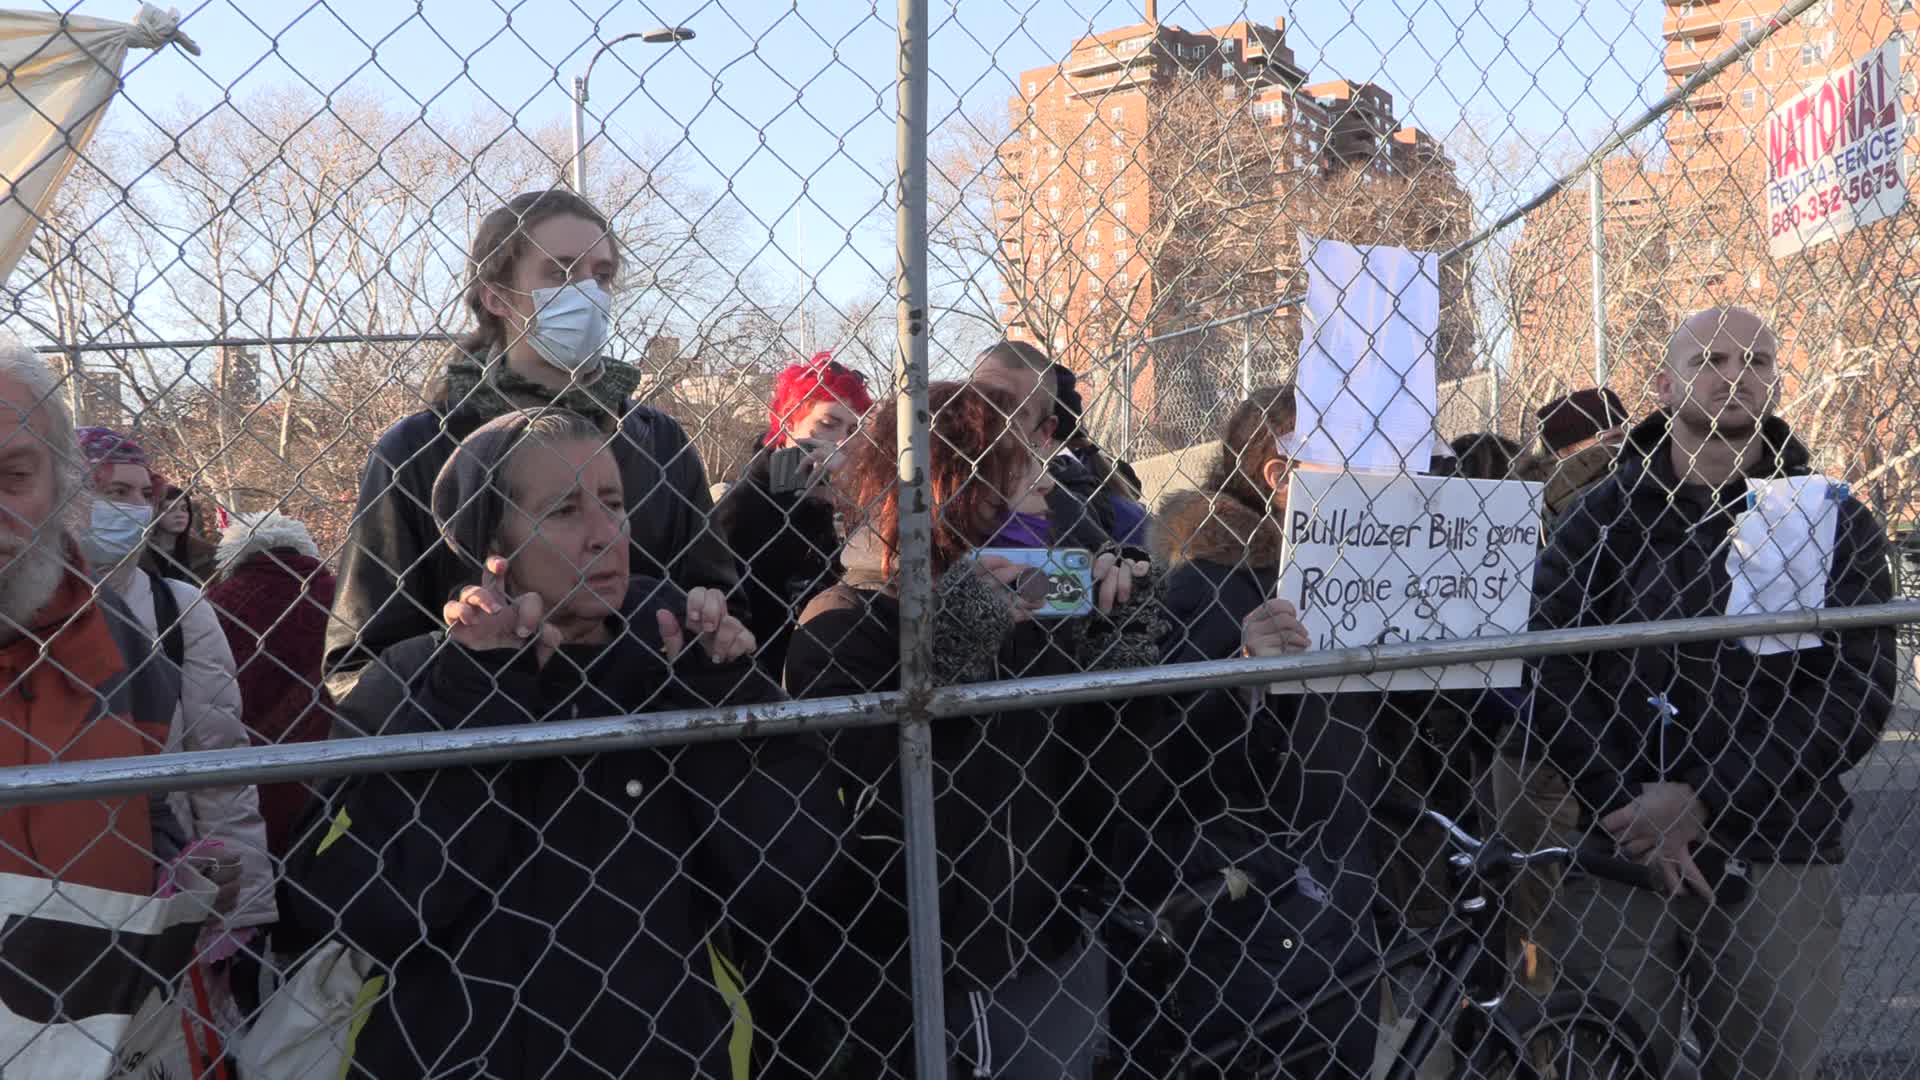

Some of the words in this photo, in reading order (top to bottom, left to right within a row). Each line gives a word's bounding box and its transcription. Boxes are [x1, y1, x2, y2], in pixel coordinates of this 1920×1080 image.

[1769, 51, 1897, 180] NATIONAL
[1769, 127, 1898, 208] RENT-A-FENCE
[1771, 163, 1899, 237] 800-352-5675
[1292, 509, 1421, 547] Bulldozer
[1429, 513, 1479, 550] Bill's
[1483, 524, 1536, 568] gone
[1300, 567, 1392, 631] Rogue
[1404, 568, 1508, 619] against
